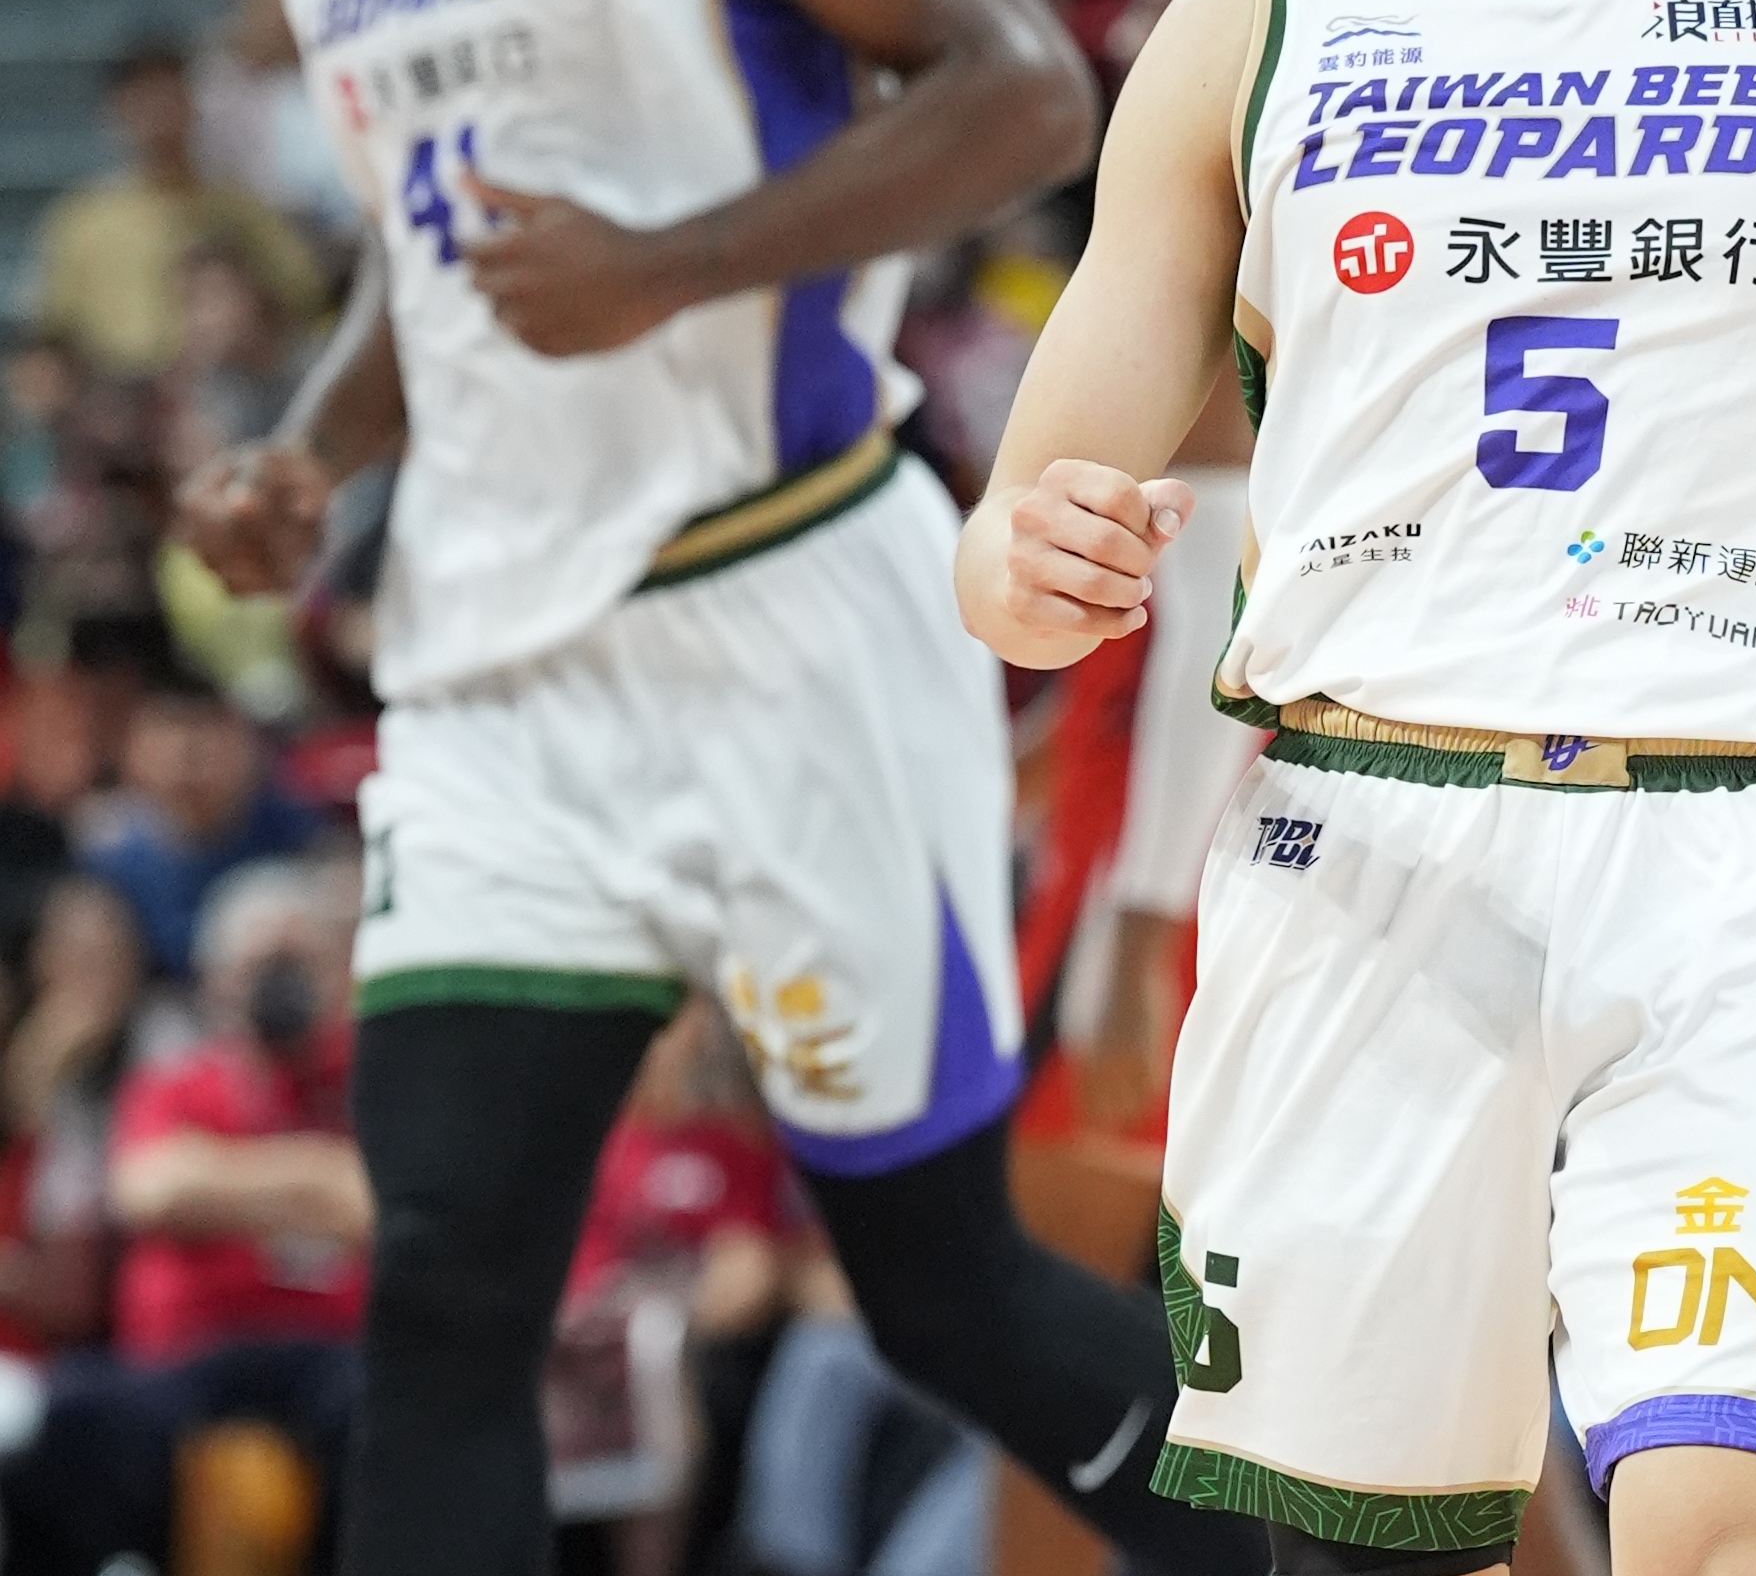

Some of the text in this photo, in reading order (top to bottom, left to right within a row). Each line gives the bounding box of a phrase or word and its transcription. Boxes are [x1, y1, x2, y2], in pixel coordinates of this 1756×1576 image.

[1318, 46, 1423, 73] 雲豹能源
[1307, 70, 1609, 126] TAIWAN
[1476, 315, 1620, 492] 5
